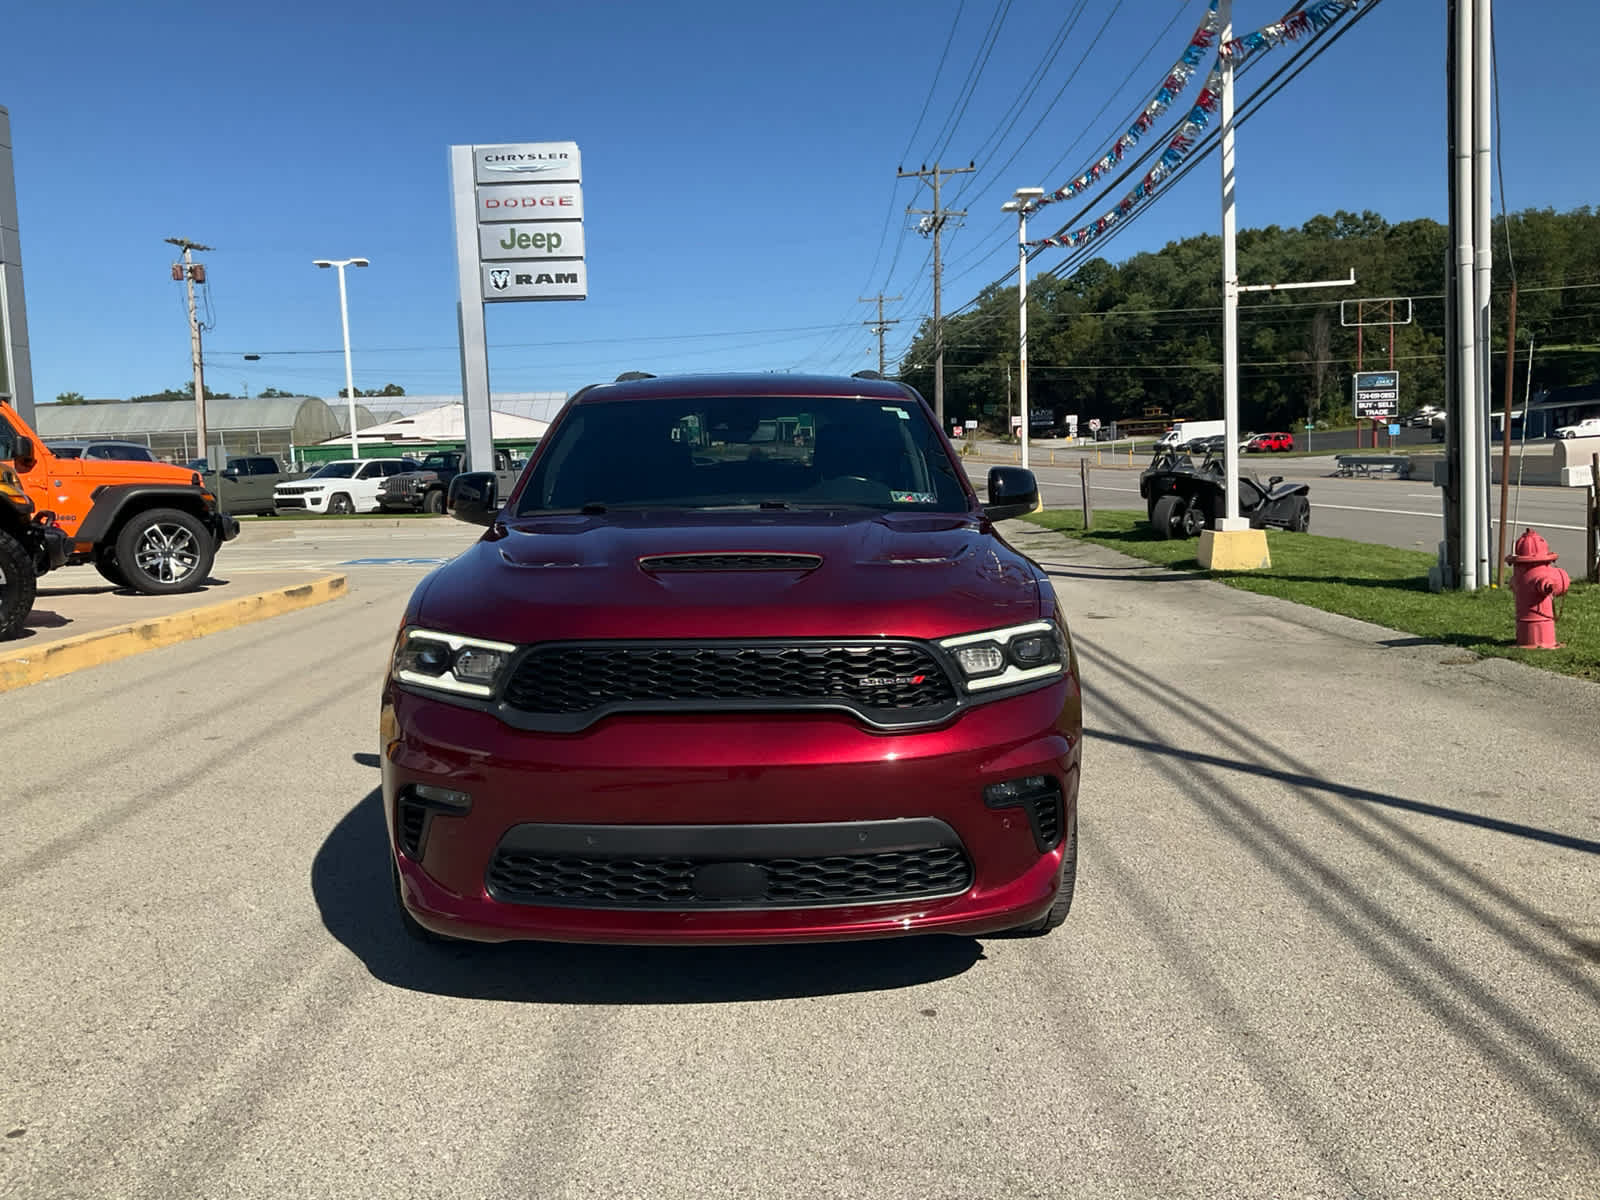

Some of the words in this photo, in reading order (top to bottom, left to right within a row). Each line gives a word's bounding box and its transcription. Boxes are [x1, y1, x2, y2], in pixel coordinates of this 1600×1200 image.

[485, 153, 568, 162] CHRYSLER
[486, 196, 574, 208] DODGE
[500, 228, 562, 252] Jeep
[516, 273, 578, 284] RAM
